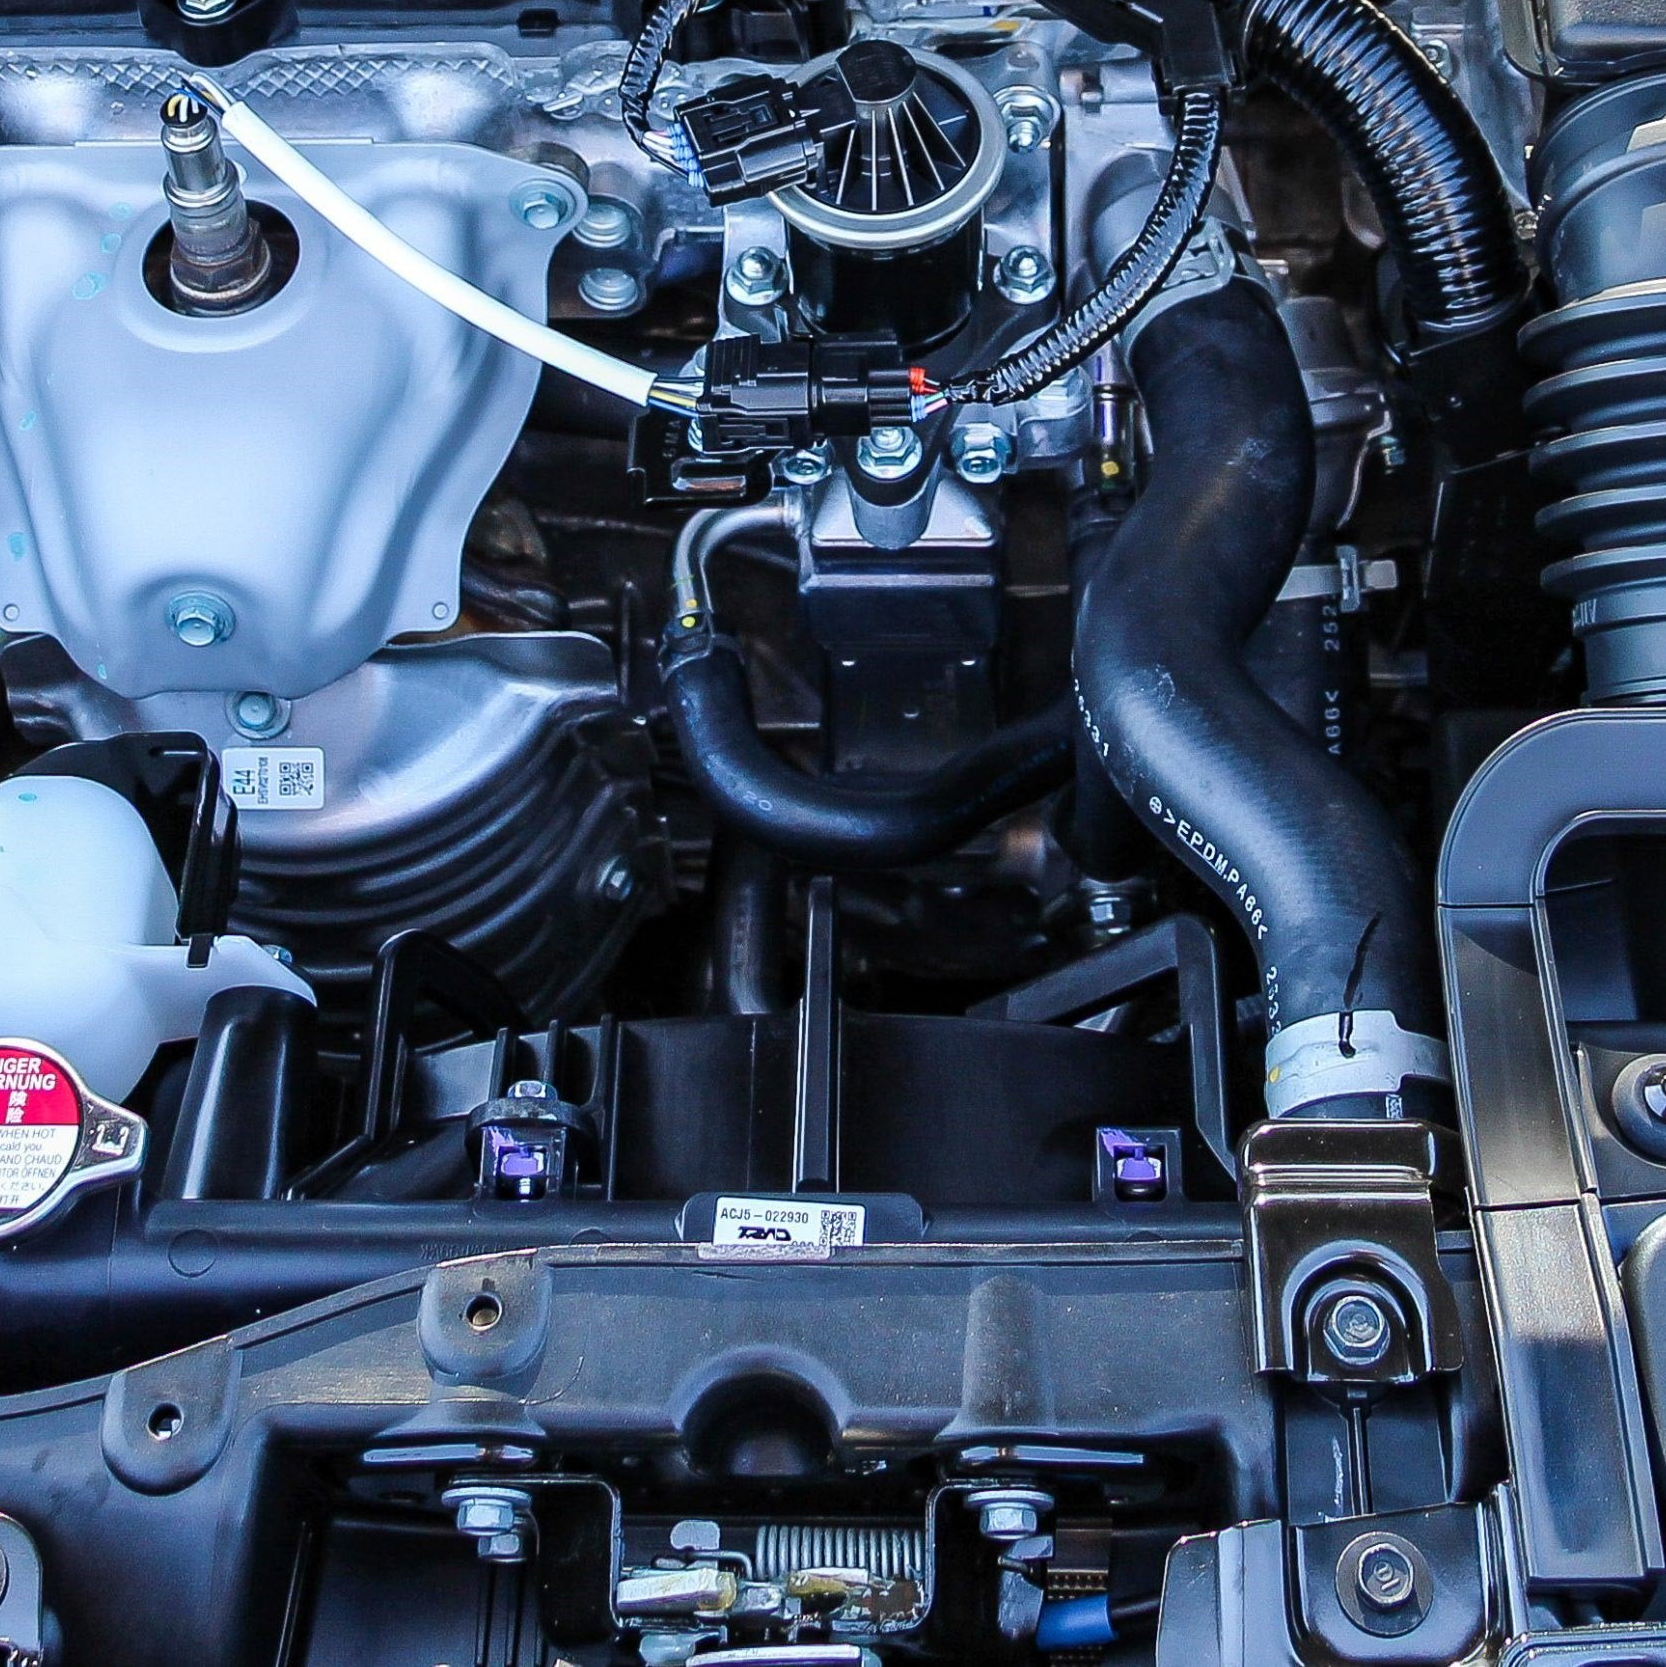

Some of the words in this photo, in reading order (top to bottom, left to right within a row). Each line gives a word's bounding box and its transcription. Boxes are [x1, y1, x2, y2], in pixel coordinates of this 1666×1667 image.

[233, 769, 255, 794] E44
[33, 1128, 57, 1139] HOT
[24, 1154, 63, 1165] CHAUD
